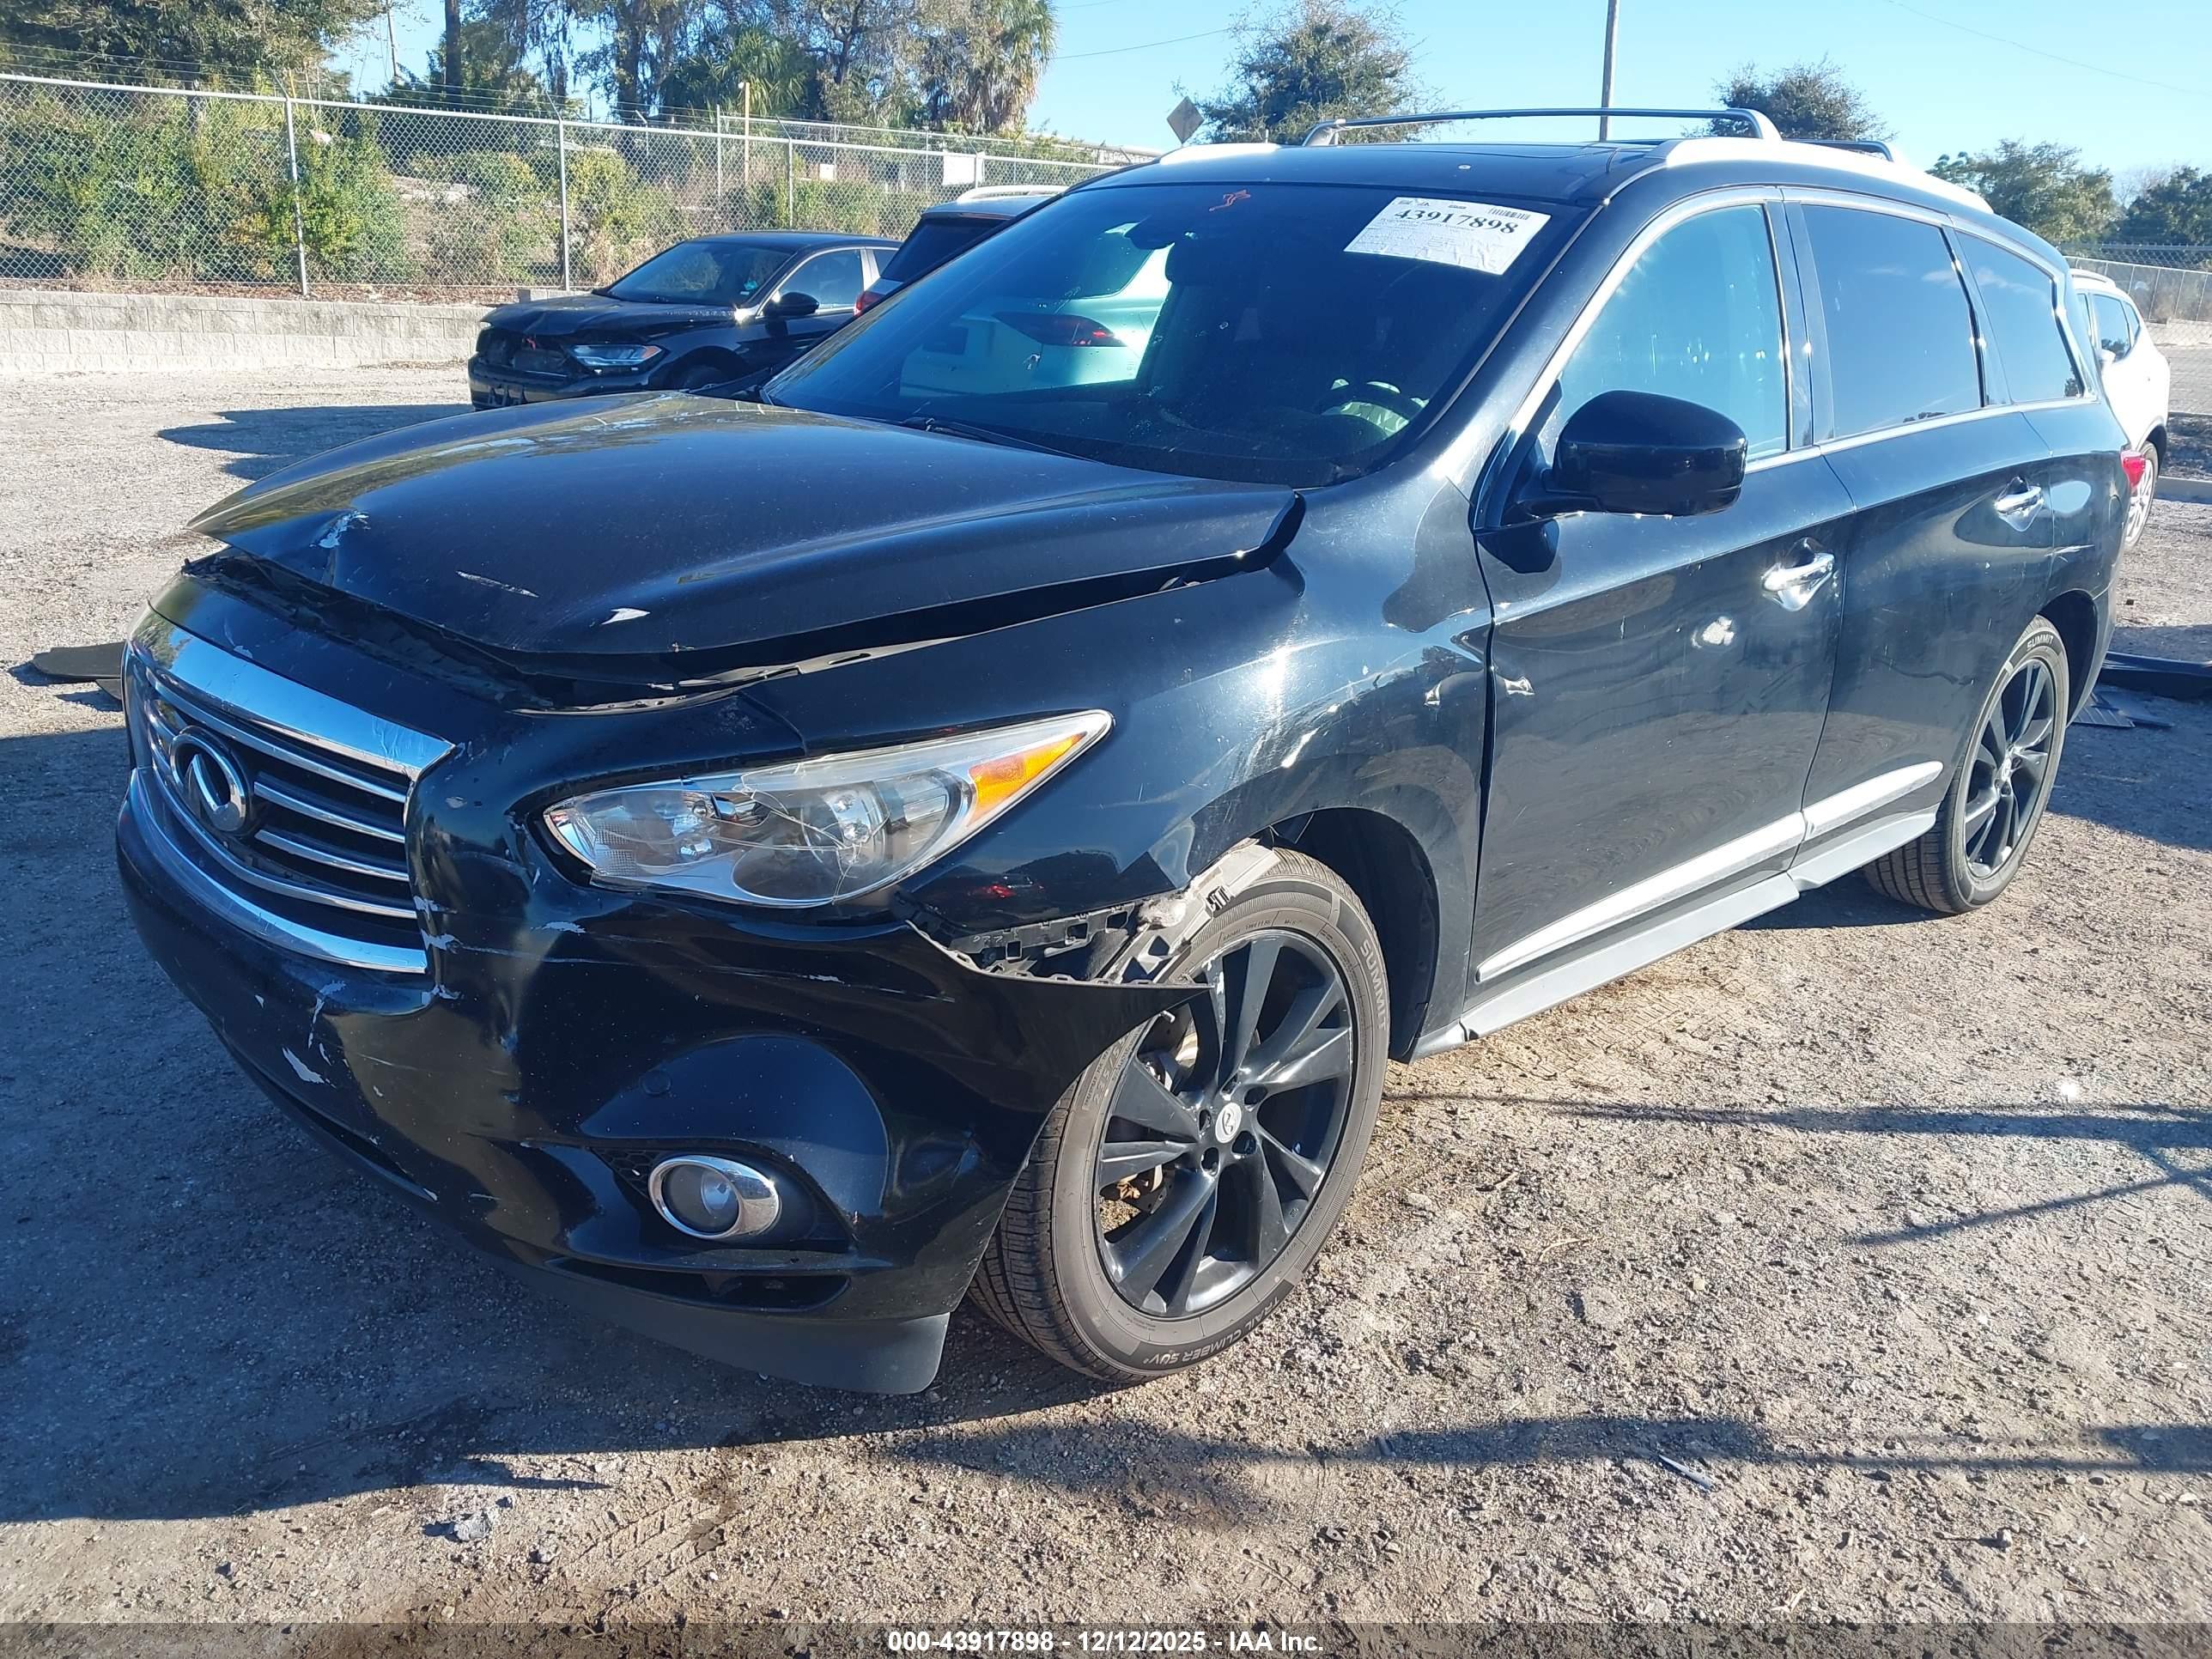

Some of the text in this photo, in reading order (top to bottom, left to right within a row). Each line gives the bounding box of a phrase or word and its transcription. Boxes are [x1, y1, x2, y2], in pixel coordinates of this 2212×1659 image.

[1395, 209, 1518, 234] 43917898
[2027, 634, 2054, 651] SUMMIT
[1359, 939, 1386, 1031] SUMMIT
[1244, 1297, 1279, 1329] TRAIL
[1182, 1328, 1242, 1364] CLIMBER
